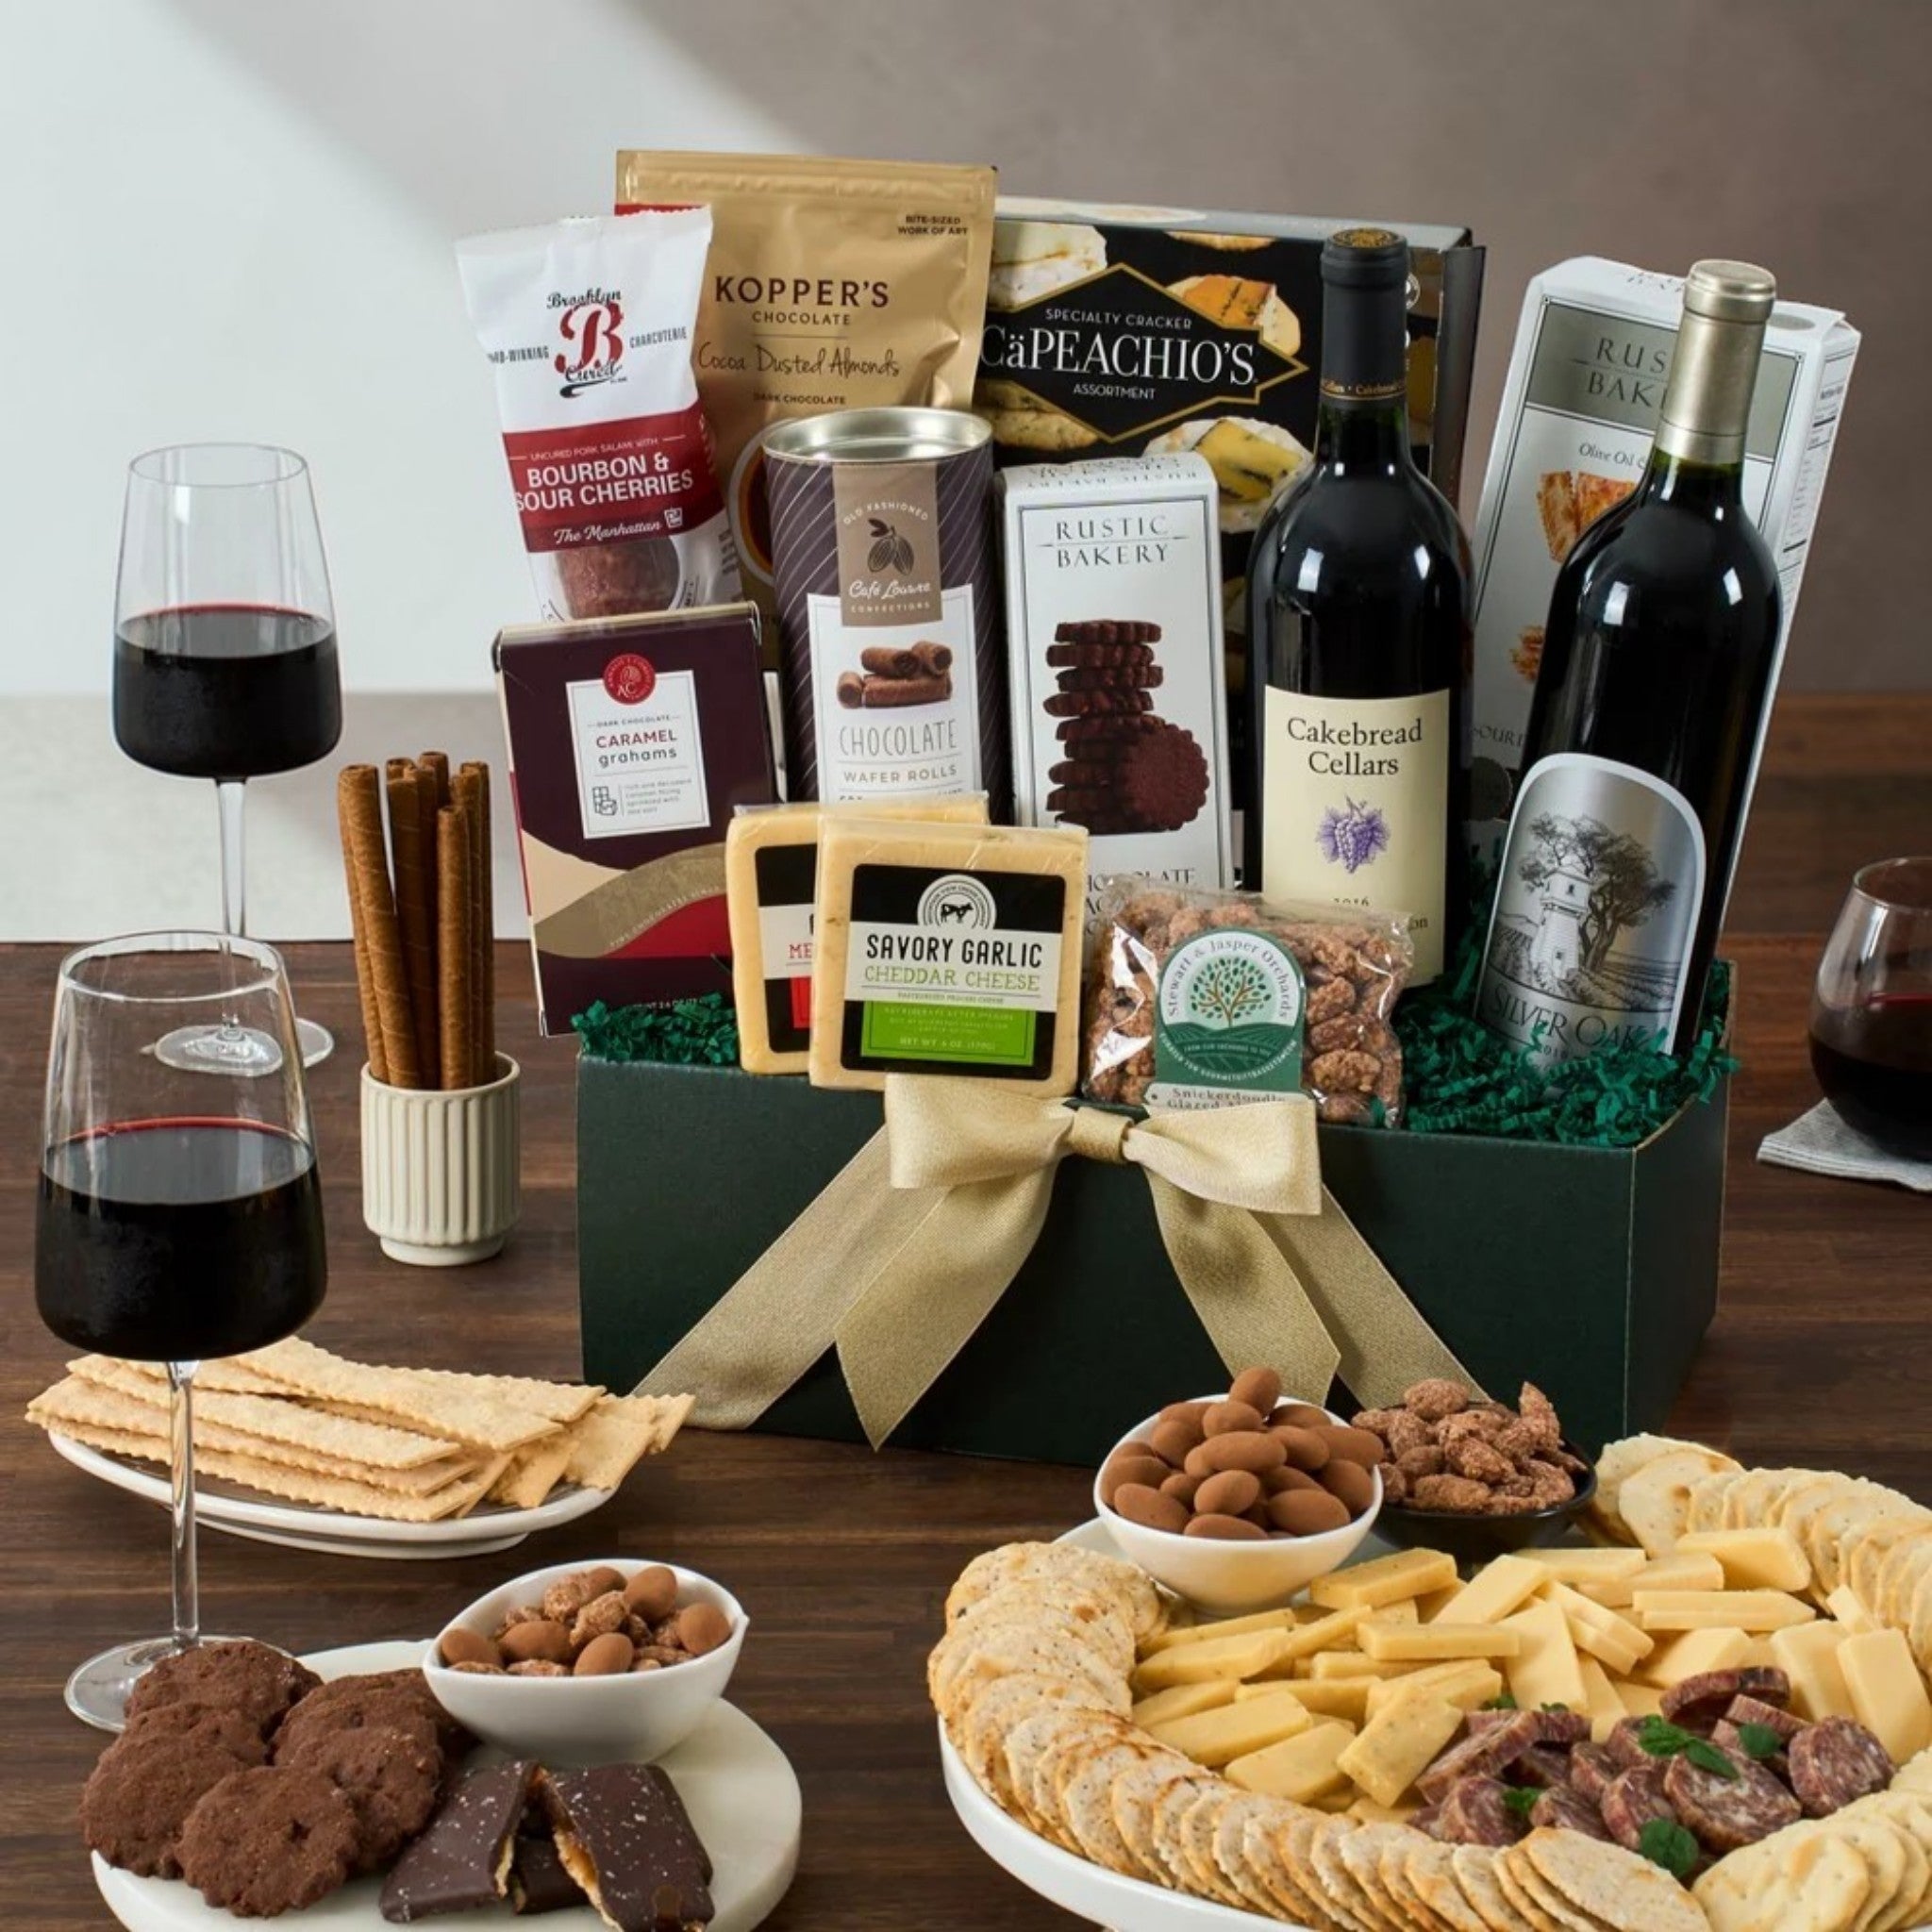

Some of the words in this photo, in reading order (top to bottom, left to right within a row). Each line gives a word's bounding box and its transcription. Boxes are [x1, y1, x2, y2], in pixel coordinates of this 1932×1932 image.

[897, 225, 929, 236] WORK
[931, 226, 944, 236] OF
[949, 226, 969, 236] ART
[906, 214, 961, 225] BITE-SIZED
[546, 287, 623, 309] Brooklyn
[714, 275, 890, 308] KOPPER'S
[751, 310, 851, 326] CHOCOLATE
[1045, 308, 1120, 325] SPECIALTY
[1125, 312, 1192, 330] CRACKER
[629, 326, 688, 350] CHARCUTERIE
[698, 341, 746, 371] Cocoa
[755, 343, 826, 375] Dusted
[829, 346, 900, 378] Almonds
[1596, 337, 1668, 374] RUS
[754, 392, 783, 404] DARK
[784, 393, 846, 406] CHOCOLATE
[1073, 383, 1157, 400] ASSORTMENT
[1588, 371, 1668, 410] BAK
[1578, 441, 1611, 462] Olive
[1614, 450, 1635, 467] Oil
[526, 454, 647, 490] BOURBON
[654, 451, 670, 472] &
[515, 488, 575, 511] SOUR
[580, 468, 693, 506] CHERRIES
[842, 508, 863, 525] OLD
[866, 501, 929, 522] FASHIONED
[553, 528, 582, 544] The
[584, 519, 662, 541] Manhattan
[1056, 514, 1169, 541] RUSTIC
[1057, 543, 1169, 569] BAKERY
[849, 579, 881, 599] Café
[851, 602, 930, 613] CONFECTIONS
[597, 719, 619, 728] DARK
[621, 714, 671, 726] CHOCOLATE
[1287, 717, 1423, 746] Cakebread
[595, 729, 678, 749] CARAMEL
[839, 718, 958, 757] CHOCOLATE
[598, 746, 677, 769] grahams
[1307, 751, 1399, 775] Cellars
[843, 771, 900, 784] WAFER
[908, 764, 958, 781] ROLLS
[789, 942, 813, 959] ME
[866, 934, 955, 963] SAVORY
[961, 940, 1042, 969] GARLIC
[864, 965, 957, 986] CHEDDAR
[965, 971, 1041, 991] CHEESE
[1167, 957, 1191, 1017] Stewart
[1211, 940, 1259, 954] Jasper
[1261, 950, 1293, 1018] Orchards
[1491, 982, 1571, 1046] SILVER
